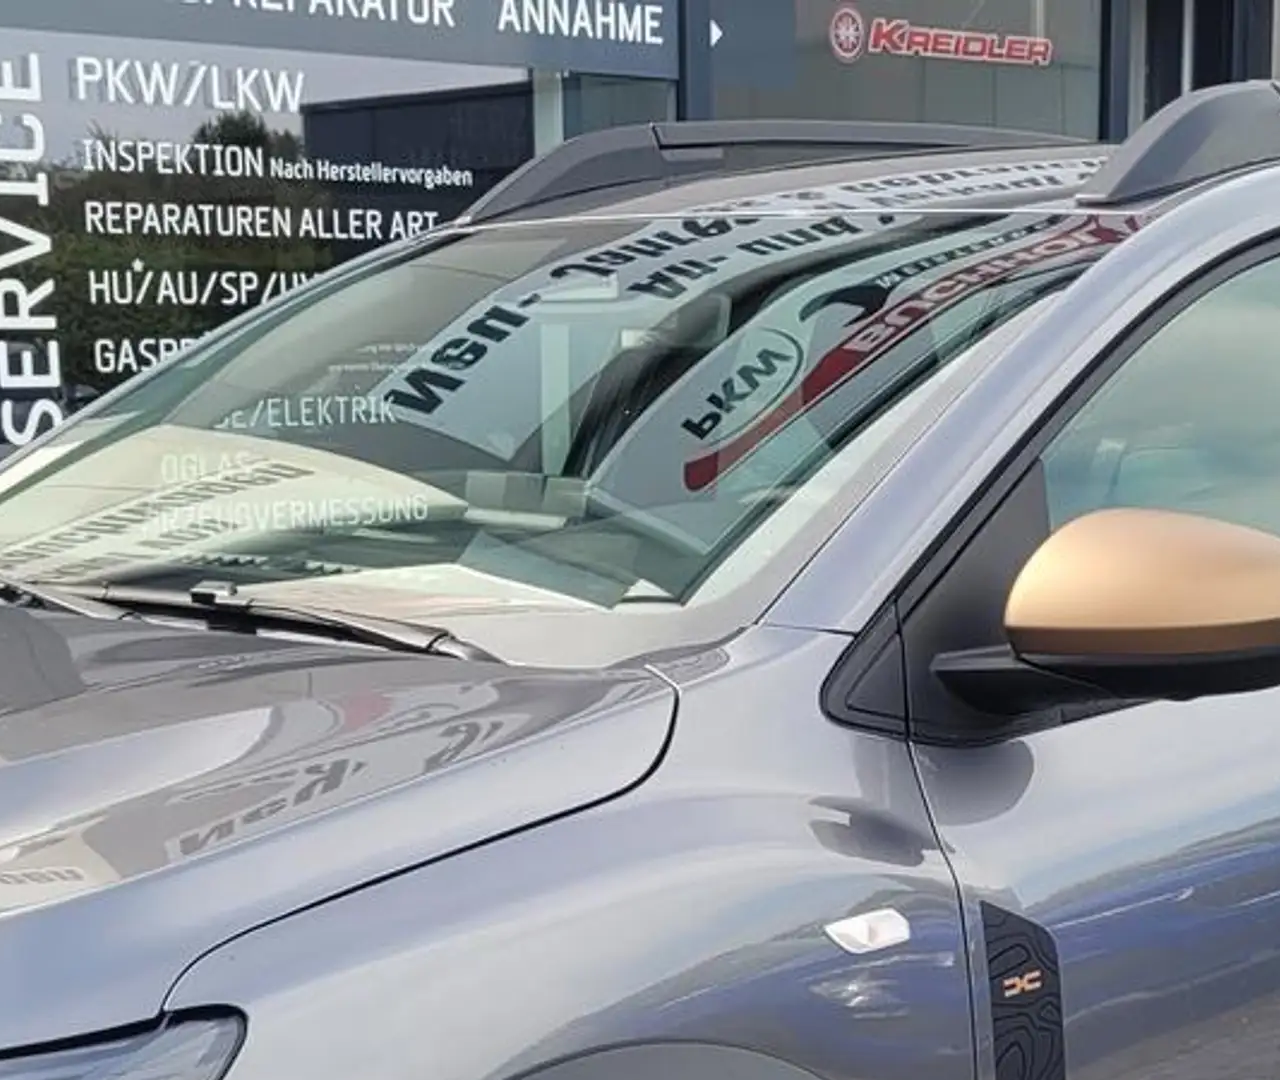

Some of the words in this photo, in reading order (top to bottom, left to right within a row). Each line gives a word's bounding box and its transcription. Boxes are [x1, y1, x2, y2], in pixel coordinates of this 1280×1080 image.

[498, 0, 663, 45] ANNAHME
[870, 18, 1053, 66] KREIDLER
[75, 56, 305, 113] PKW/LKW
[81, 139, 264, 178] INSPEKTION
[270, 156, 315, 181] Nach
[317, 159, 473, 189] Herstellervorgaben
[84, 199, 291, 239] REPARATUREN
[298, 207, 383, 241] ALLER
[389, 210, 439, 240] ART
